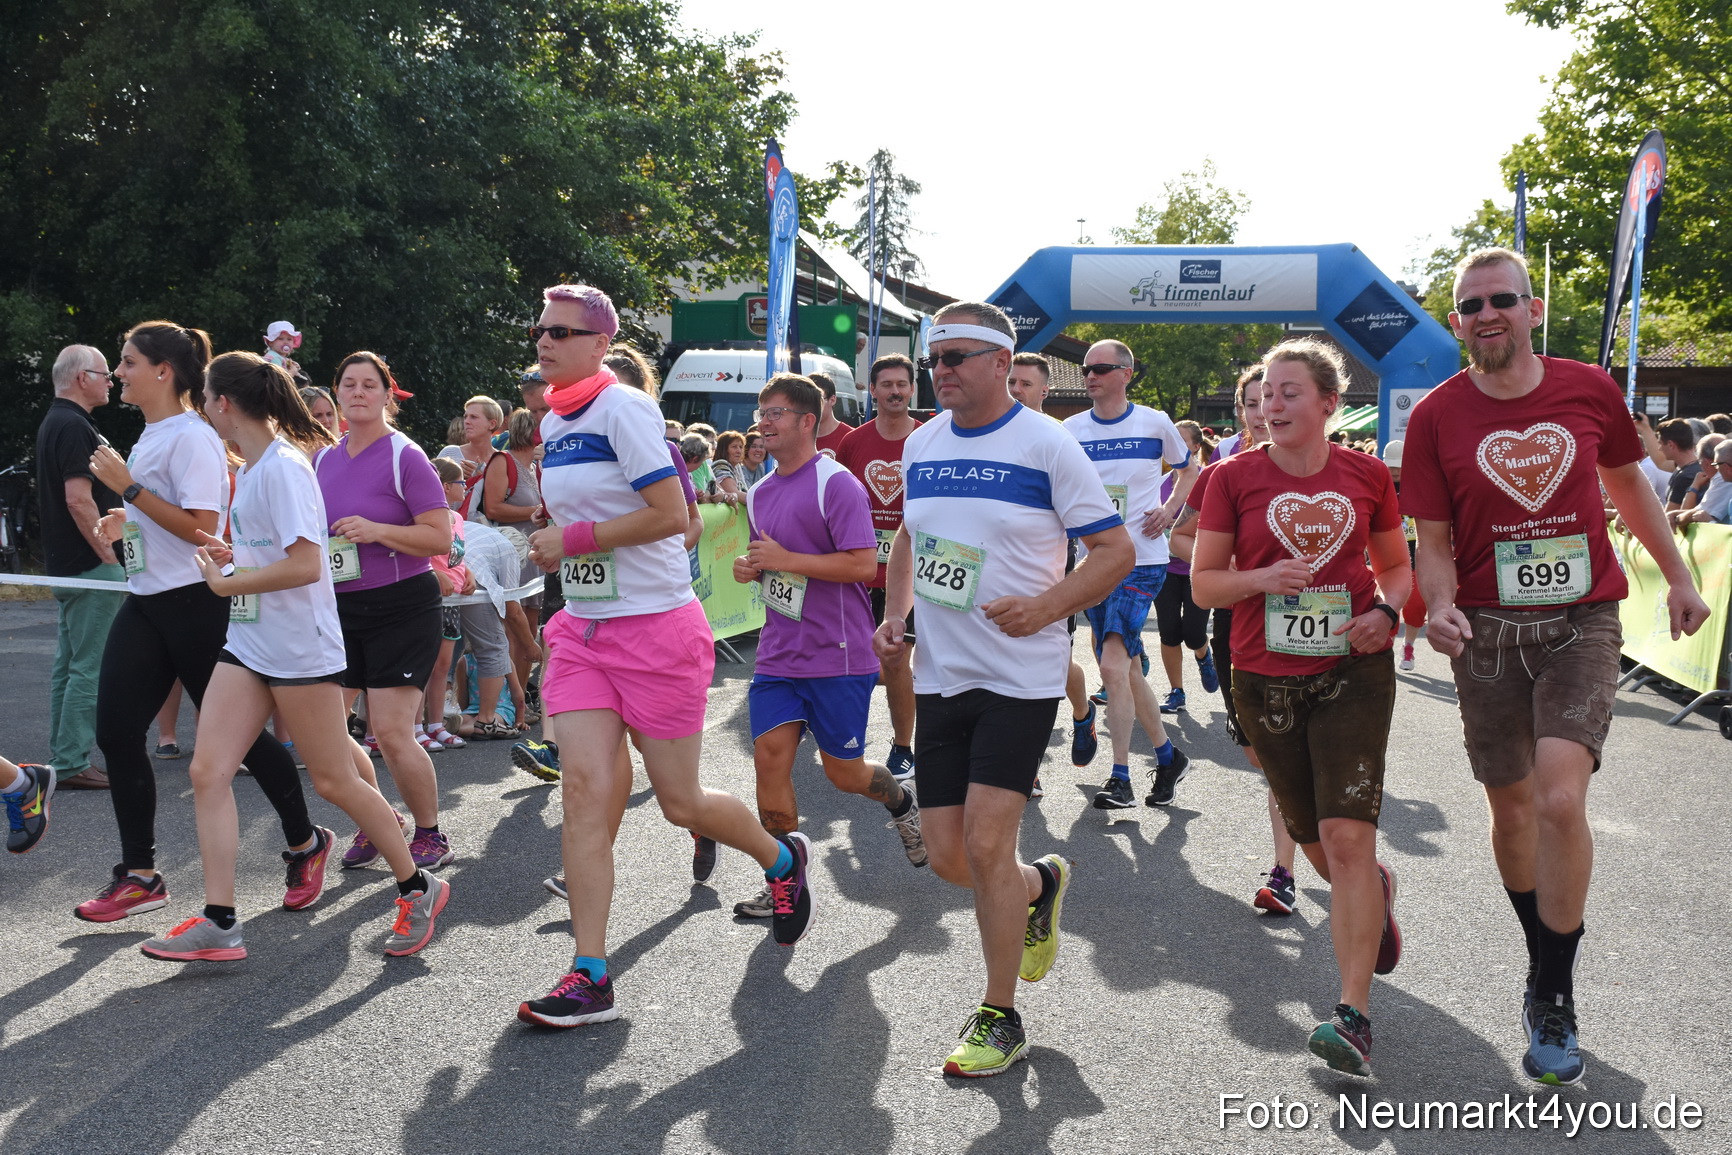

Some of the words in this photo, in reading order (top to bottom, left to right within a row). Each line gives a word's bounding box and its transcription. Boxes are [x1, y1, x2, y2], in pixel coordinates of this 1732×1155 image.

[1187, 267, 1219, 276] Fischer
[1164, 284, 1256, 301] firmenlauf
[1011, 315, 1040, 325] cher
[1351, 315, 1366, 323] und
[675, 371, 714, 380] abavent
[1097, 441, 1141, 452] PLAST
[1505, 453, 1551, 470] Martin
[876, 474, 898, 482] Albert
[937, 466, 1011, 483] PLAST
[1294, 523, 1332, 534] Karin
[1491, 512, 1578, 534] Steuerberatung
[1531, 528, 1558, 538] Herz
[876, 541, 891, 554] 70
[563, 562, 606, 585] 2429
[916, 556, 967, 591] 2428
[1517, 561, 1571, 588] 699
[769, 578, 793, 604] 634
[1517, 587, 1551, 595] Kremmel
[1551, 585, 1574, 593] Martin
[1283, 614, 1329, 639] 701
[1287, 637, 1309, 645] Weber
